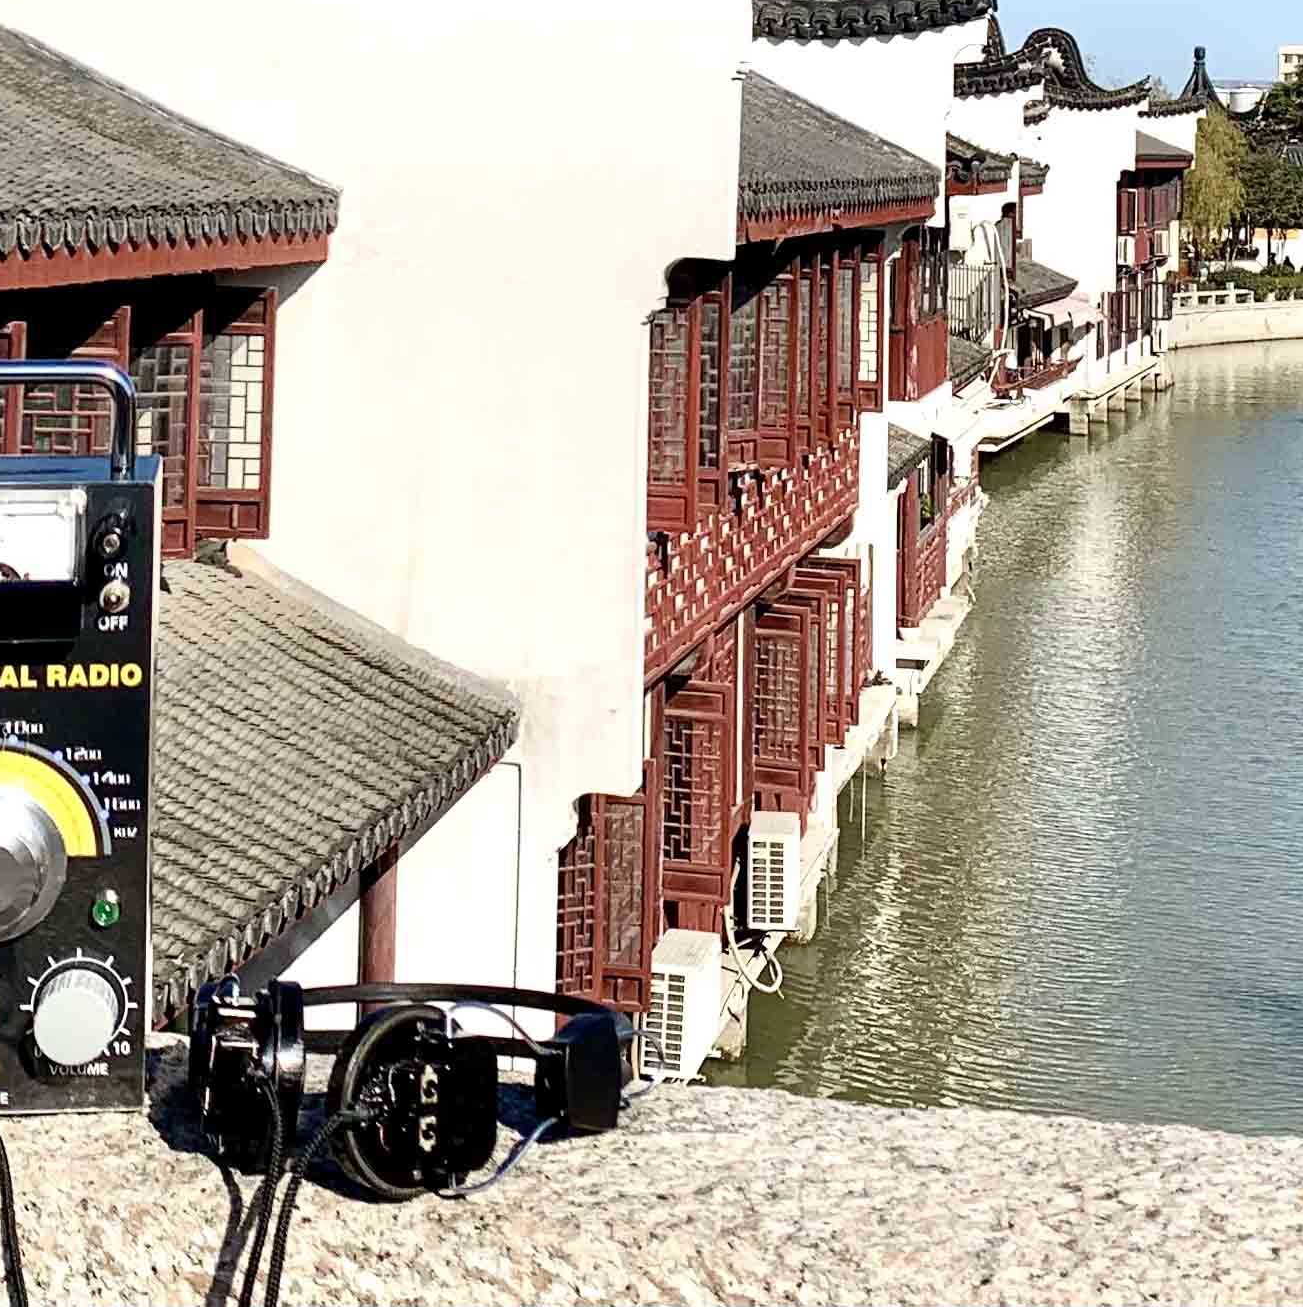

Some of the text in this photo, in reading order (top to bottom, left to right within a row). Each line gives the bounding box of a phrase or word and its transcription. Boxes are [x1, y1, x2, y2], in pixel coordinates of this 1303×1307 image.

[104, 562, 128, 579] ON
[98, 615, 128, 631] OFF
[46, 663, 142, 688] RADIO
[5, 720, 44, 734] 1000
[112, 1041, 131, 1055] 10
[49, 1062, 110, 1076] VOLUME
